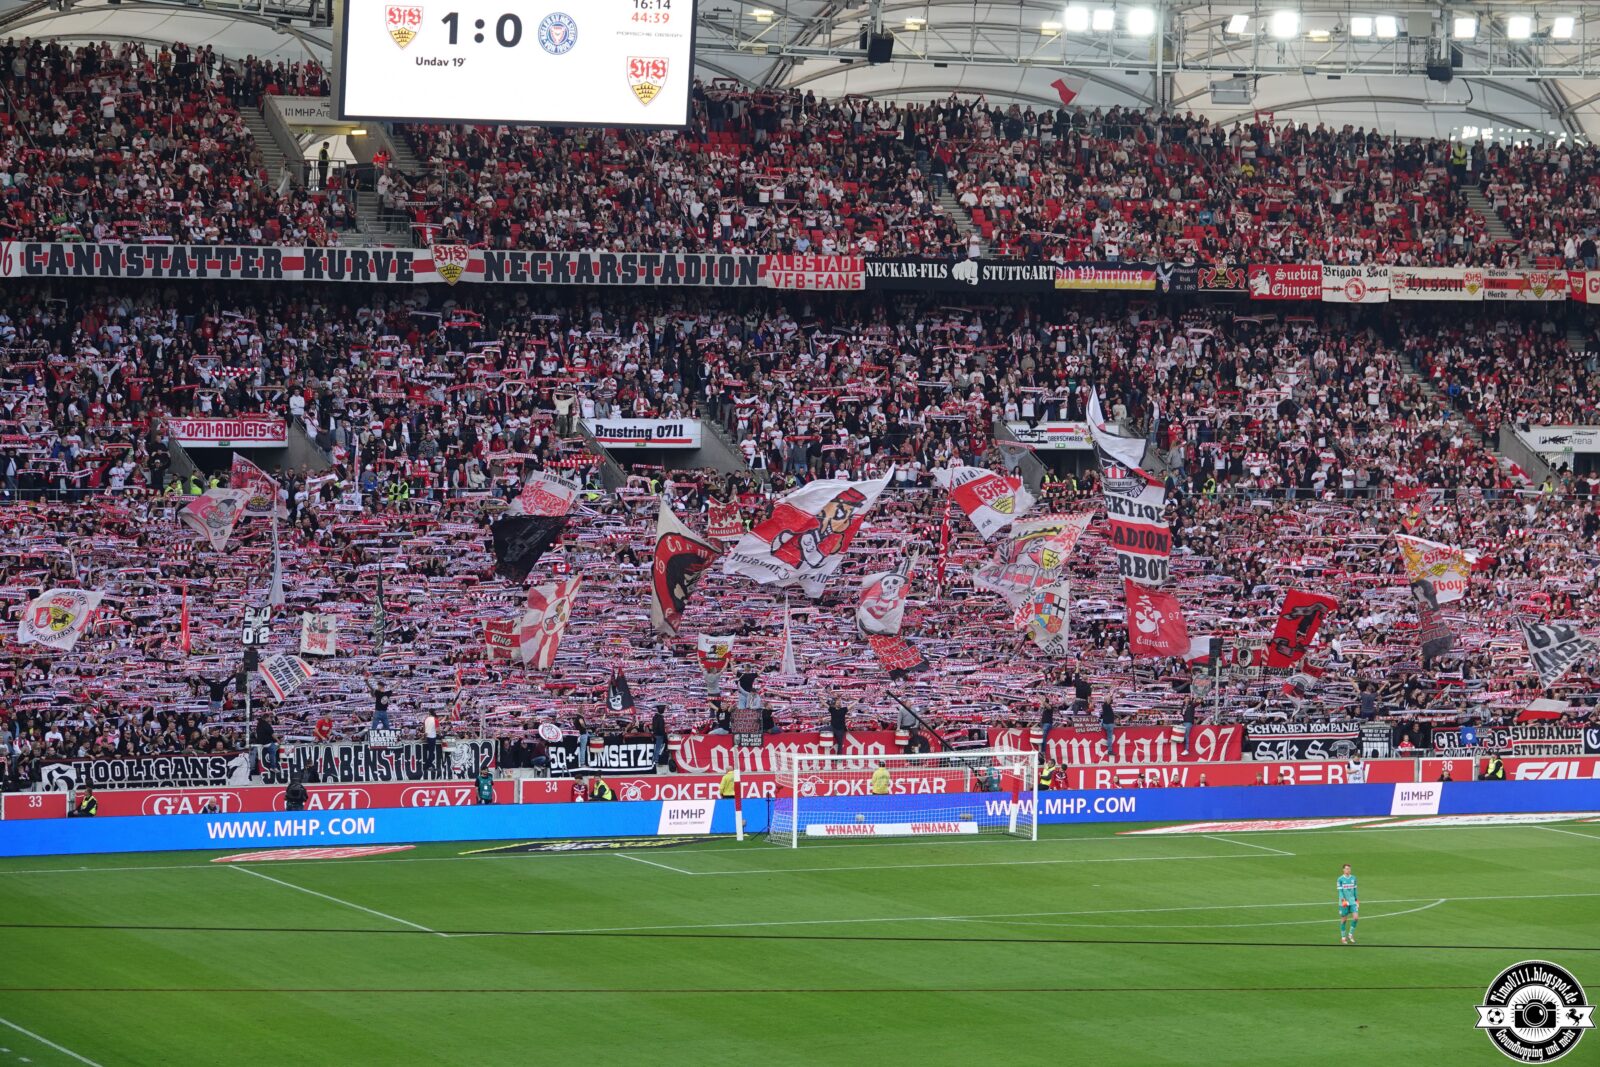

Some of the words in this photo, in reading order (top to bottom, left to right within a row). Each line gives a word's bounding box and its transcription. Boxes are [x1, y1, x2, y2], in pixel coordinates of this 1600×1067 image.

[631, 12, 670, 24] 44:39
[415, 56, 449, 67] Undav
[25, 243, 283, 280] CANNSTATTER
[303, 247, 414, 282] KURVE
[484, 250, 762, 287] NECKARSTADION
[769, 254, 863, 272] ALBSTADT
[865, 262, 948, 280] NECKAR-FILS
[982, 264, 1055, 281] STUTTGART
[771, 272, 861, 289] VFB-FANS
[215, 422, 268, 437] ADDICTS
[595, 424, 653, 440] Brustring
[656, 424, 684, 438] 0711
[1246, 723, 1308, 735] SCHWABEN
[1309, 721, 1360, 734] KOMPANIE
[1194, 728, 1235, 762] 97
[1513, 744, 1583, 756] STUTTGART
[72, 756, 227, 785] HOOLIGANS
[1442, 760, 1453, 772] 36
[545, 781, 558, 793] 34
[28, 796, 42, 808] 33
[207, 816, 375, 840] WWW.MHP.COM
[825, 824, 875, 835] WINAMAX
[911, 822, 960, 834] WINAMAX
